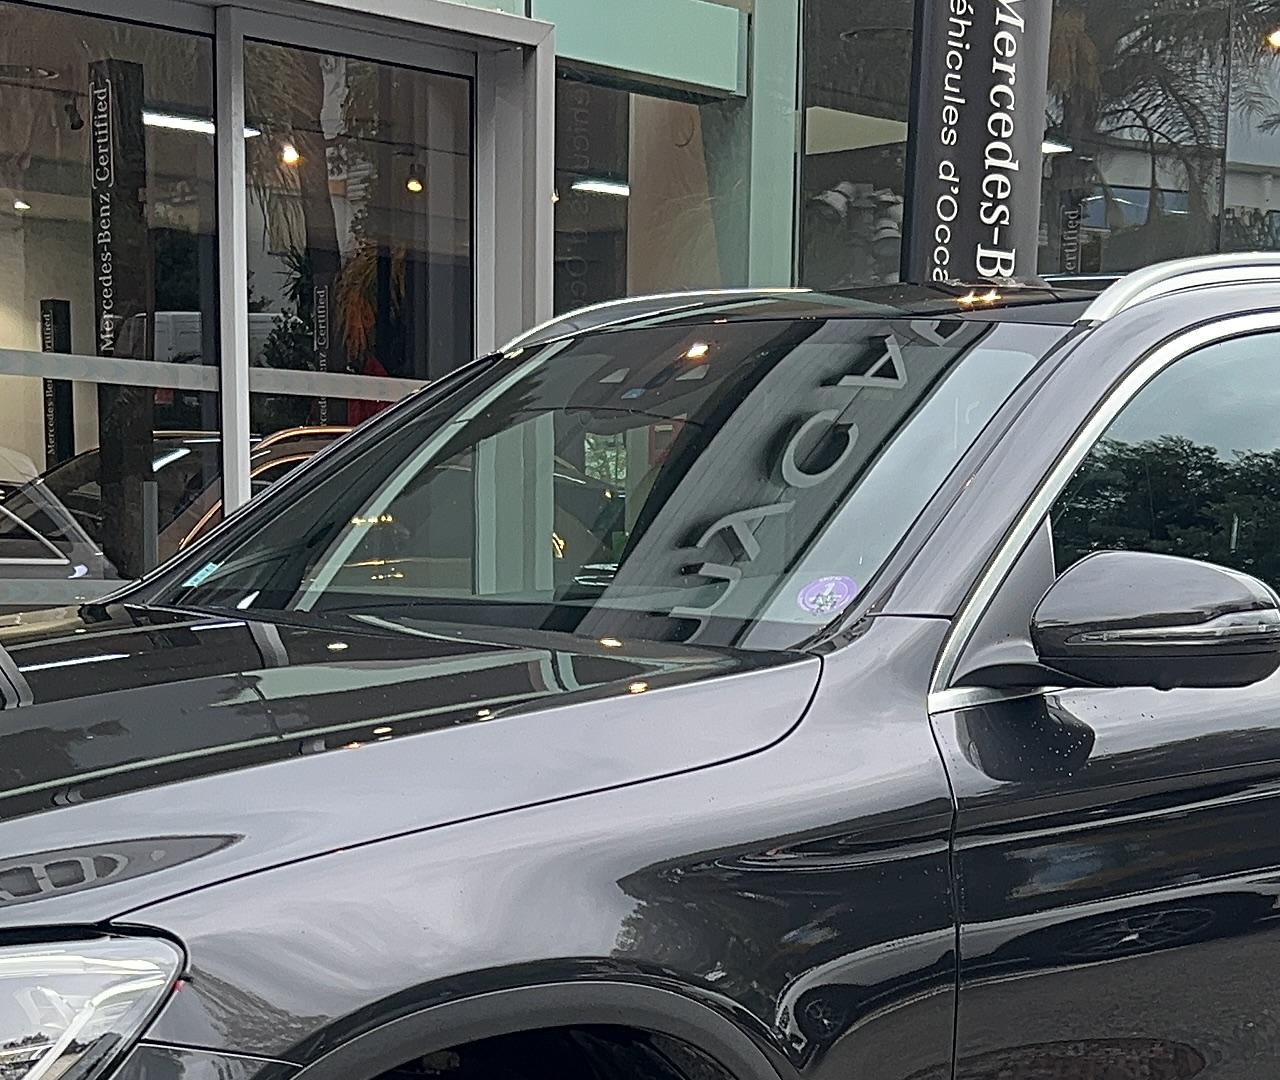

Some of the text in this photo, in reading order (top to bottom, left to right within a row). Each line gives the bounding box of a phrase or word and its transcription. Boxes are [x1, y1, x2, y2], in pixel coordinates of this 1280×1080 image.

[93, 87, 115, 352] Mercedes-Benz Certified
[1063, 209, 1079, 273] ertified
